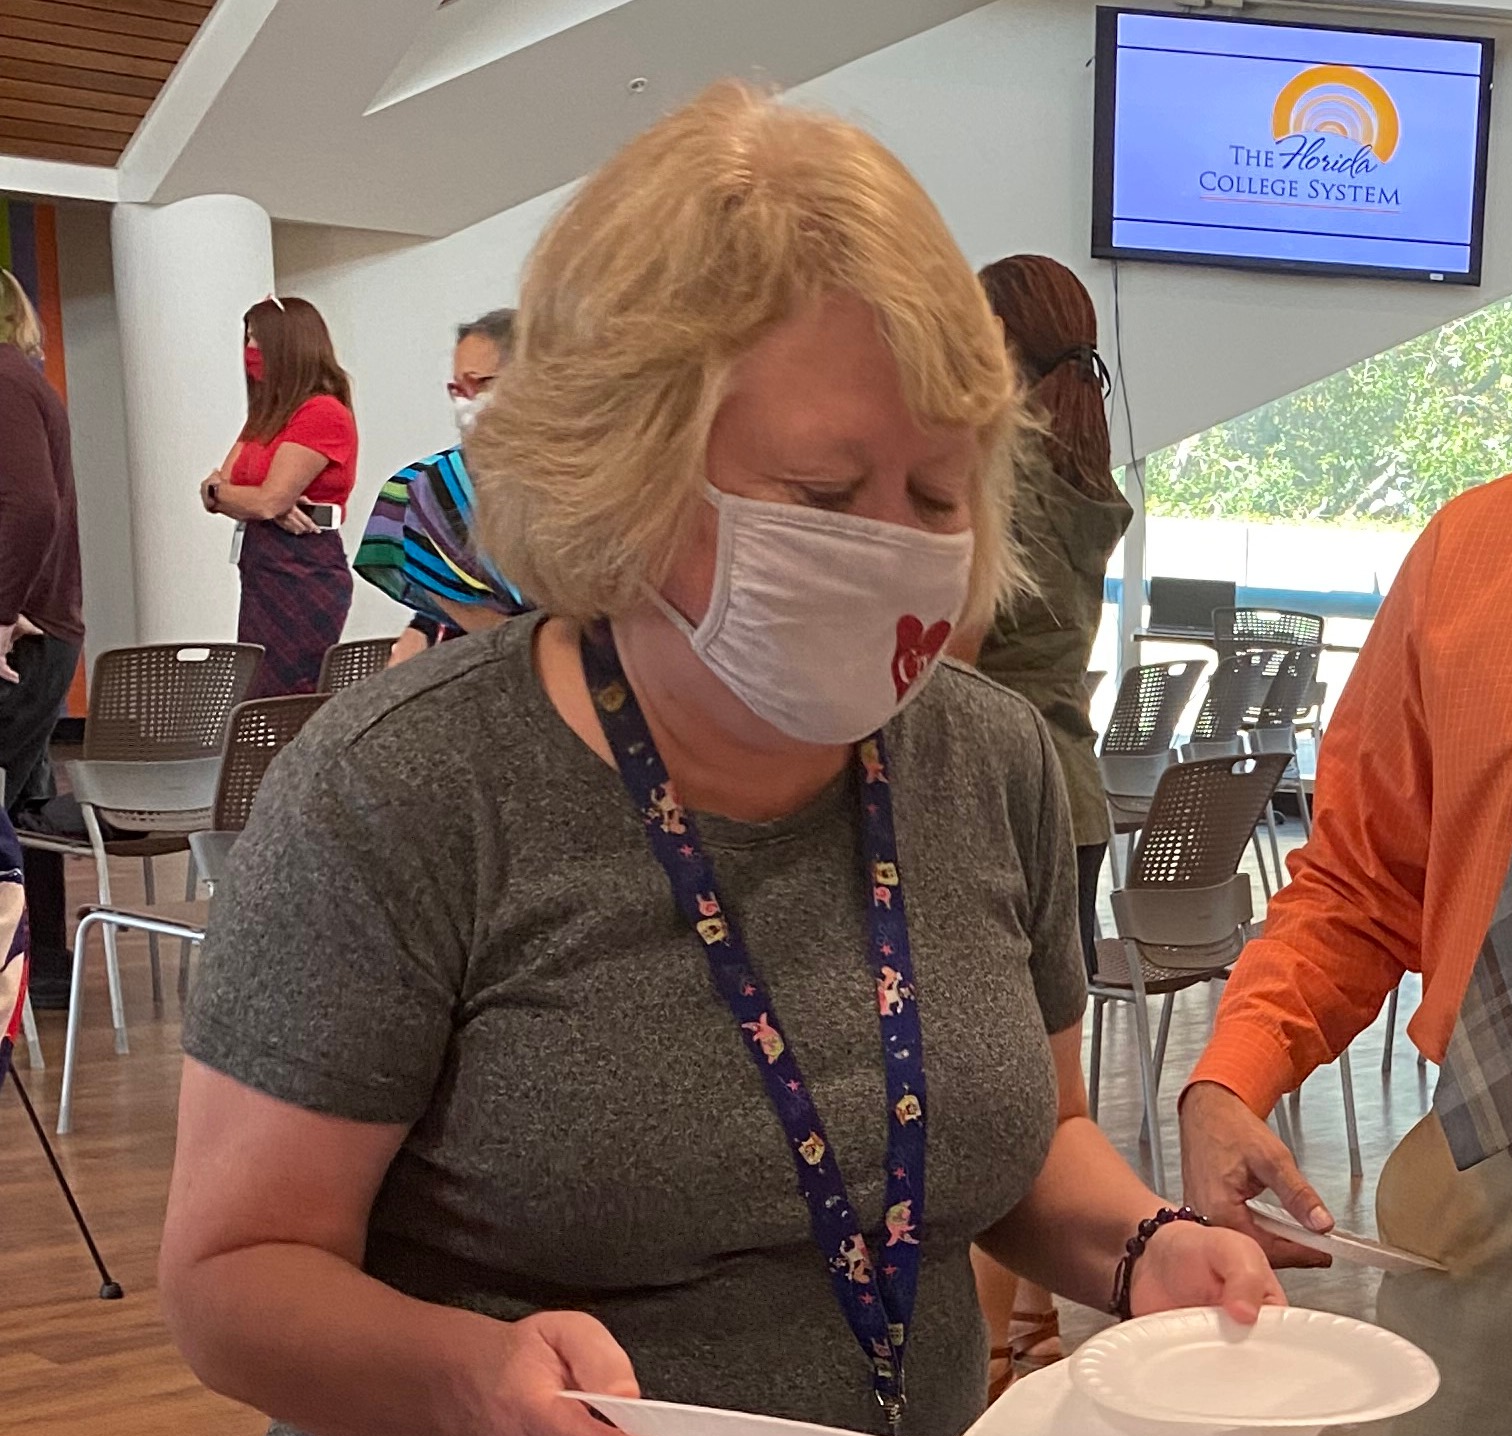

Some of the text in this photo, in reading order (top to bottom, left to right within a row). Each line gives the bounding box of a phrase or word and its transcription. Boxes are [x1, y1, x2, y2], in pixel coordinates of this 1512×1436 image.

[1229, 134, 1377, 178] THE Florida
[1200, 171, 1401, 205] COLLEGE SYSTEM
